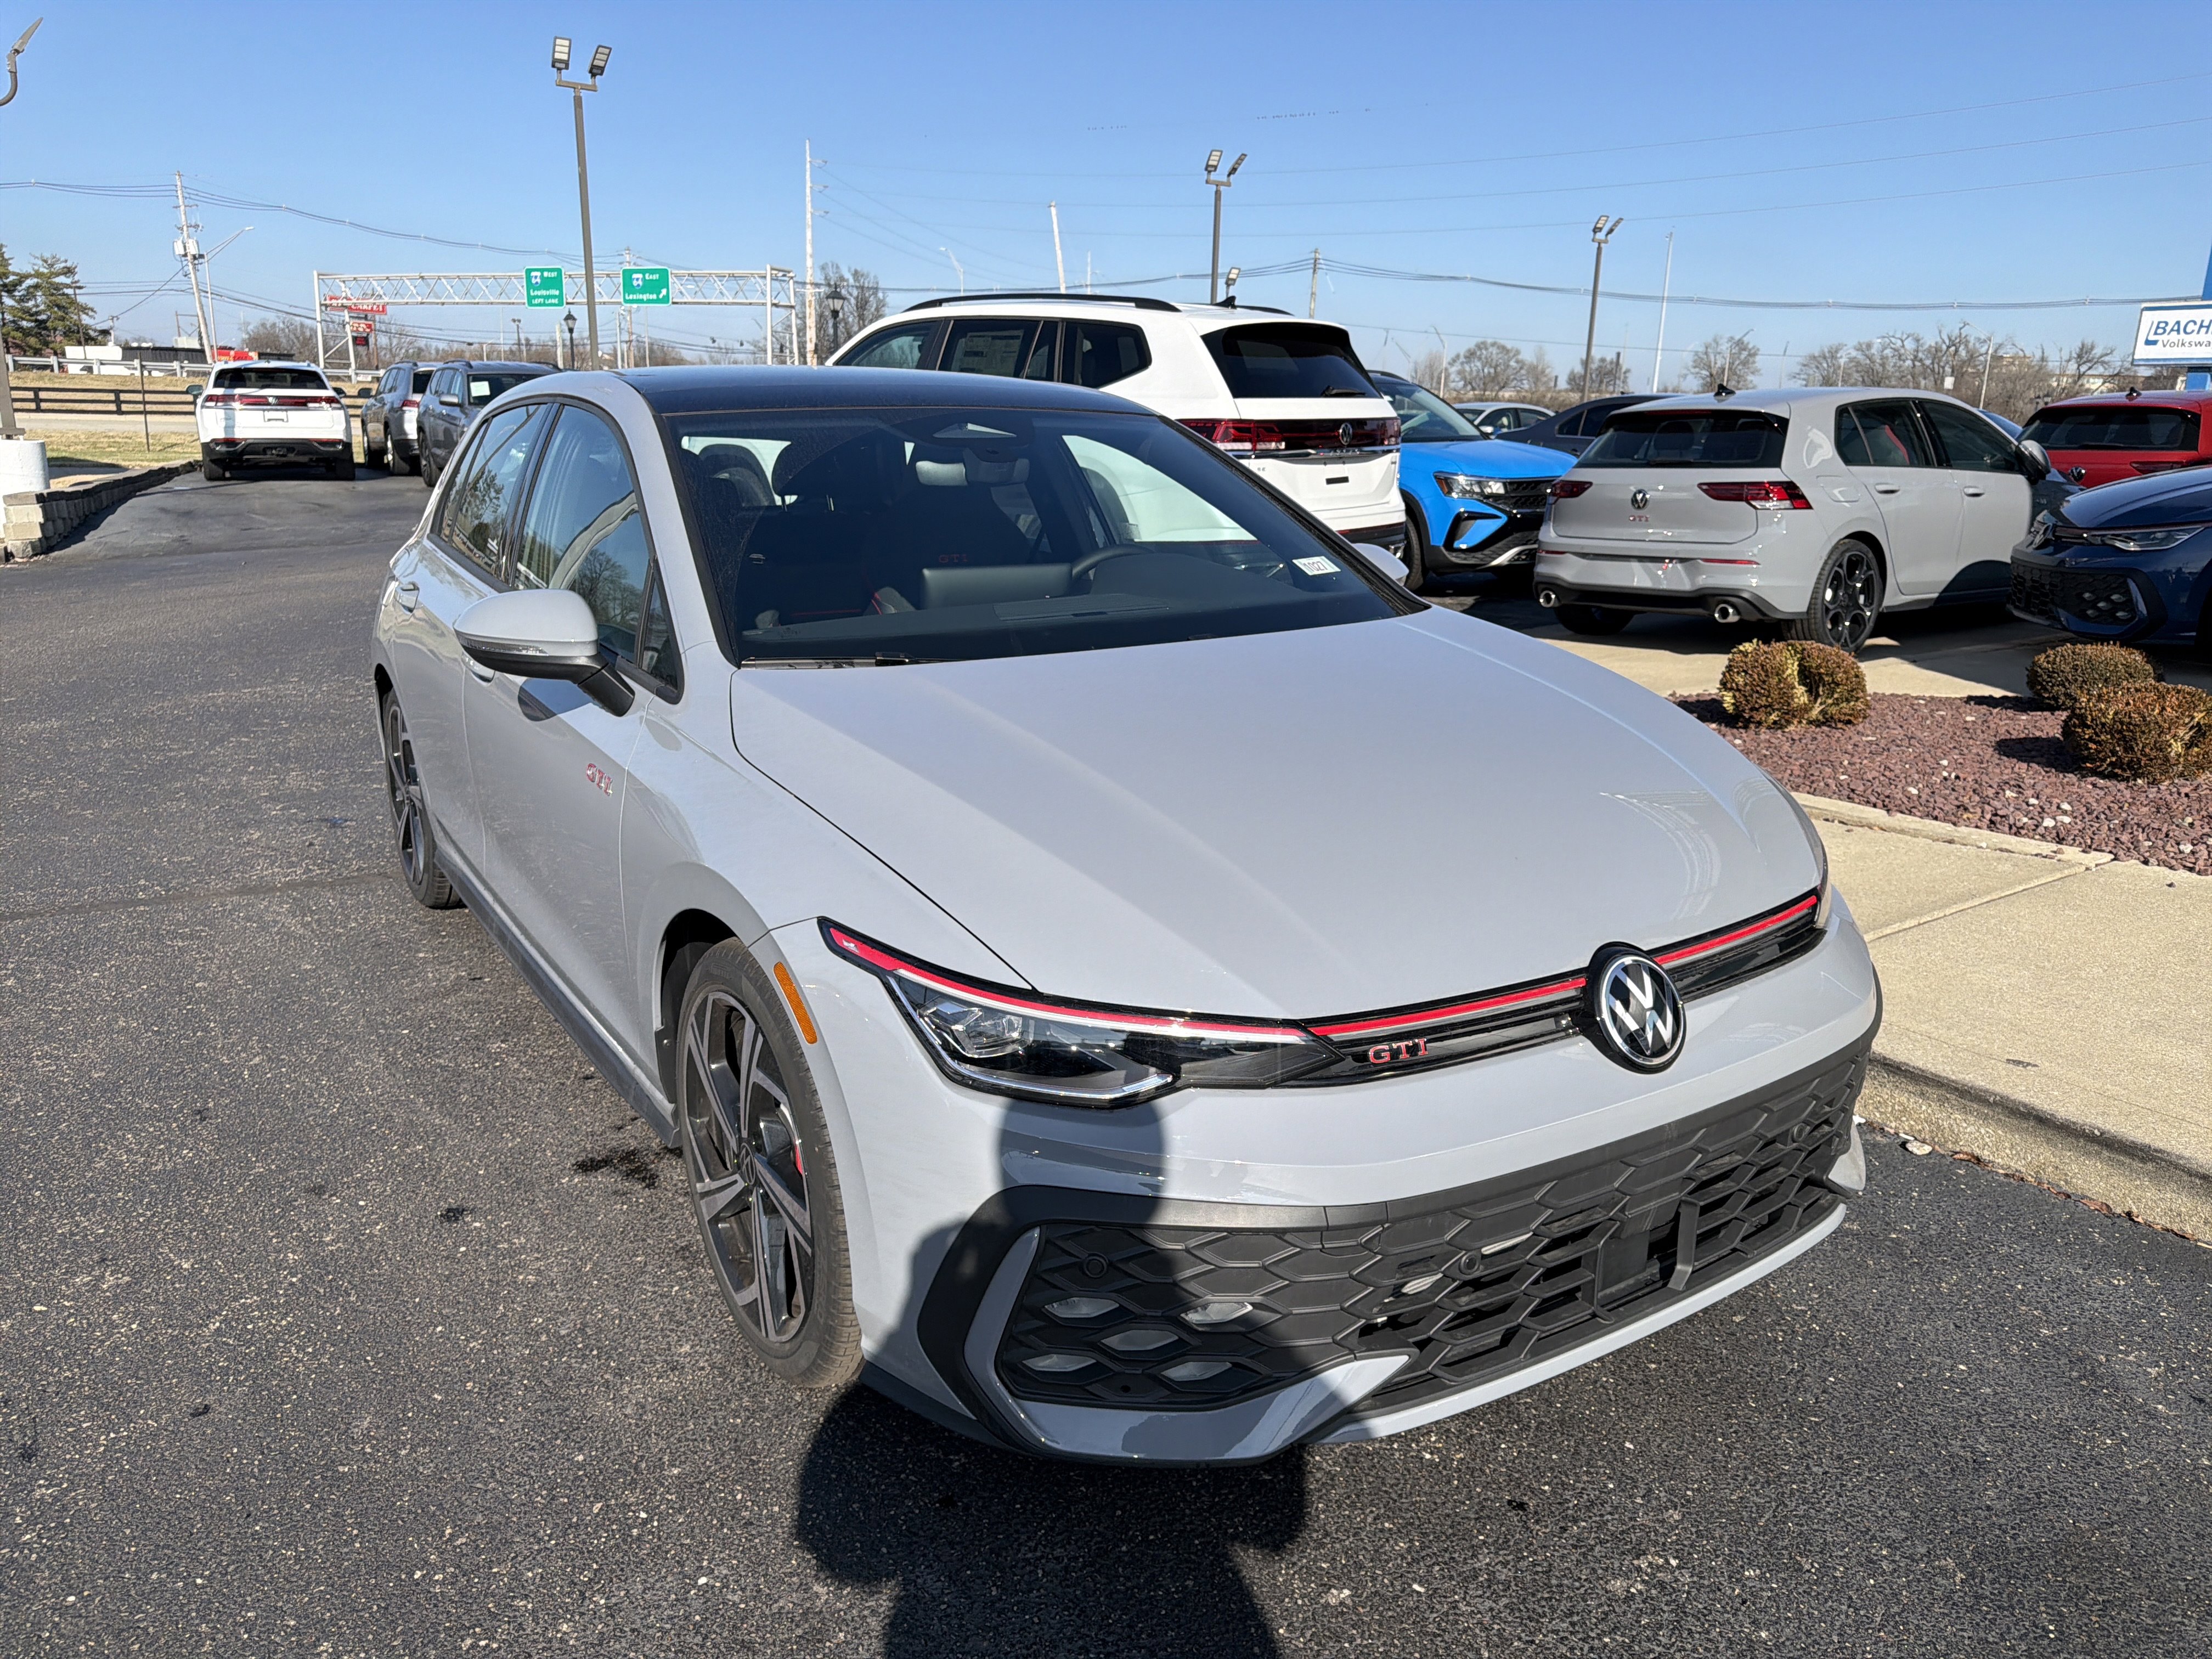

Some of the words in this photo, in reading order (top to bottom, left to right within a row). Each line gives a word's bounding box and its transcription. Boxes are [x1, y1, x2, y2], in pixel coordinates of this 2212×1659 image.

[2153, 319, 2212, 336] BACH
[2162, 339, 2212, 348] Volkswa
[1302, 561, 1328, 572] 1027
[1369, 1037, 1429, 1064] GTI
